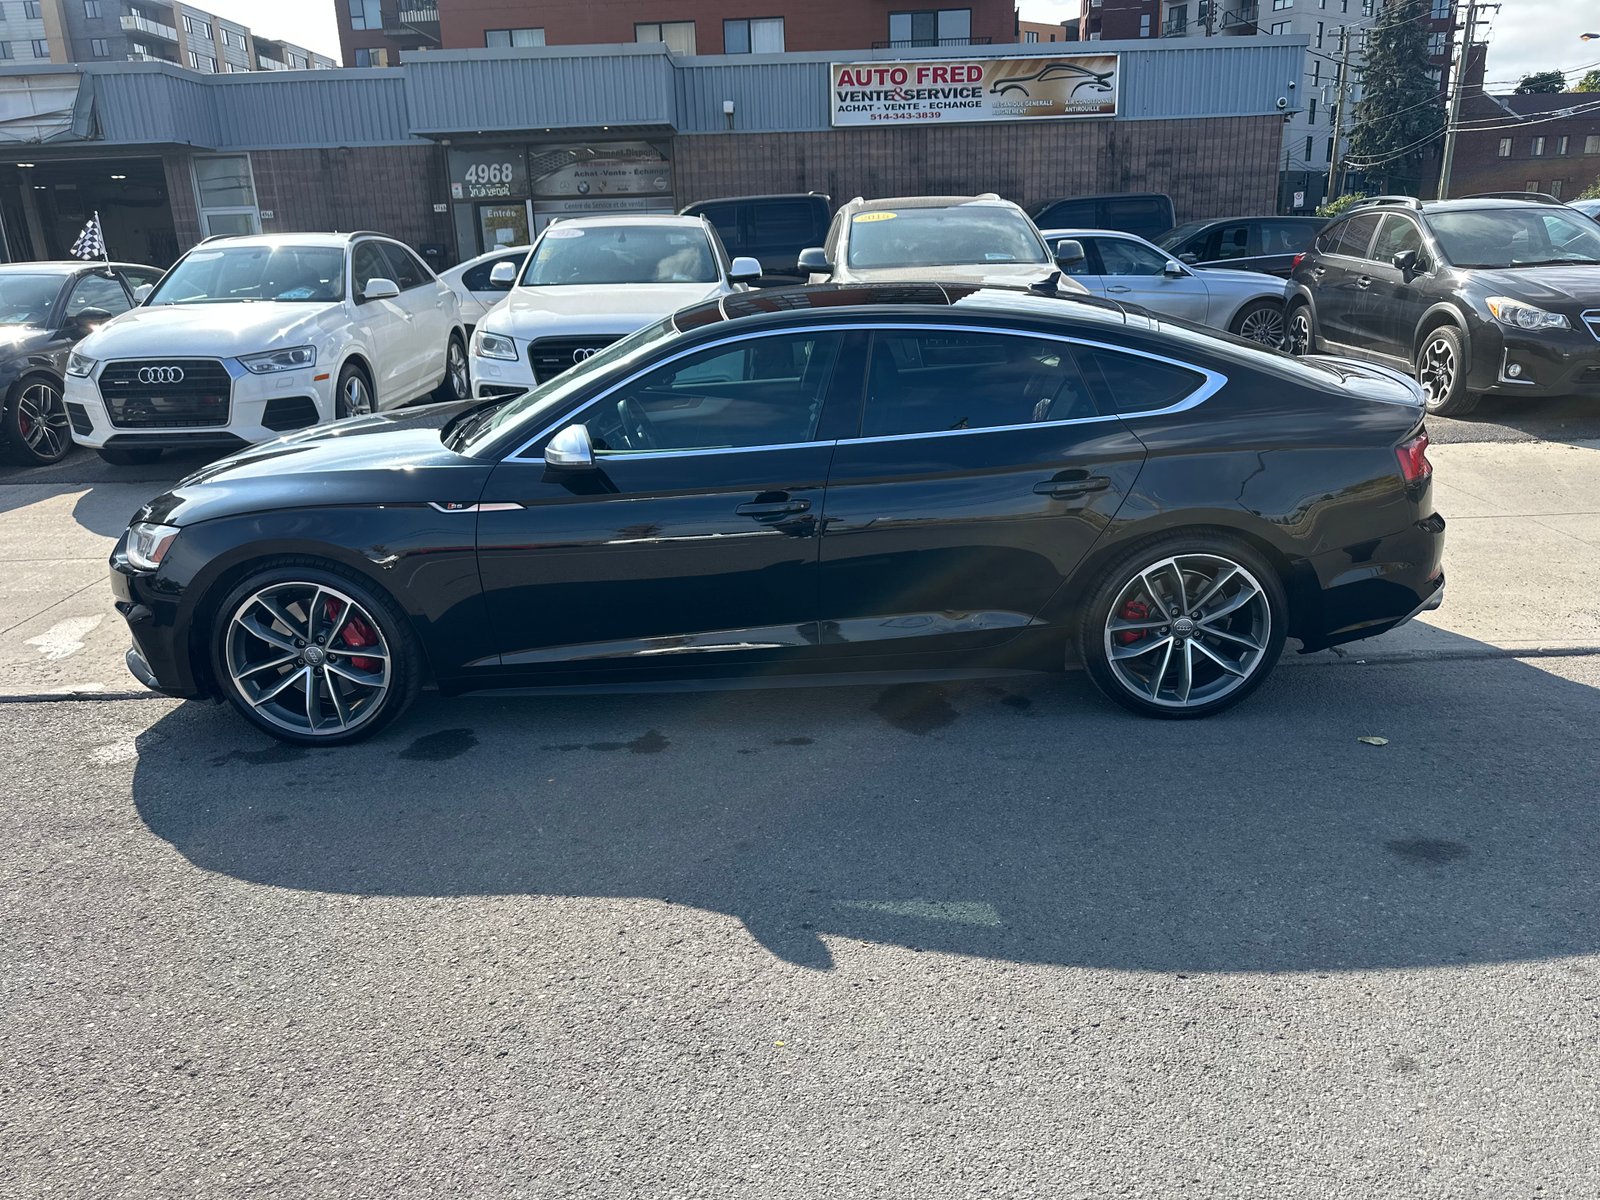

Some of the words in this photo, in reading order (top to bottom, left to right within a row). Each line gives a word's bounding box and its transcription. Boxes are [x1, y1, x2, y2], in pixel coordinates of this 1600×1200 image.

[837, 68, 908, 87] AUTO
[916, 65, 983, 84] FRED
[838, 103, 874, 112] ACHAT
[883, 102, 920, 111] VENTE
[929, 100, 982, 109] ECHANGE
[870, 111, 941, 121] 514-343-3839
[465, 163, 513, 183] 4968
[574, 170, 598, 178] Achat
